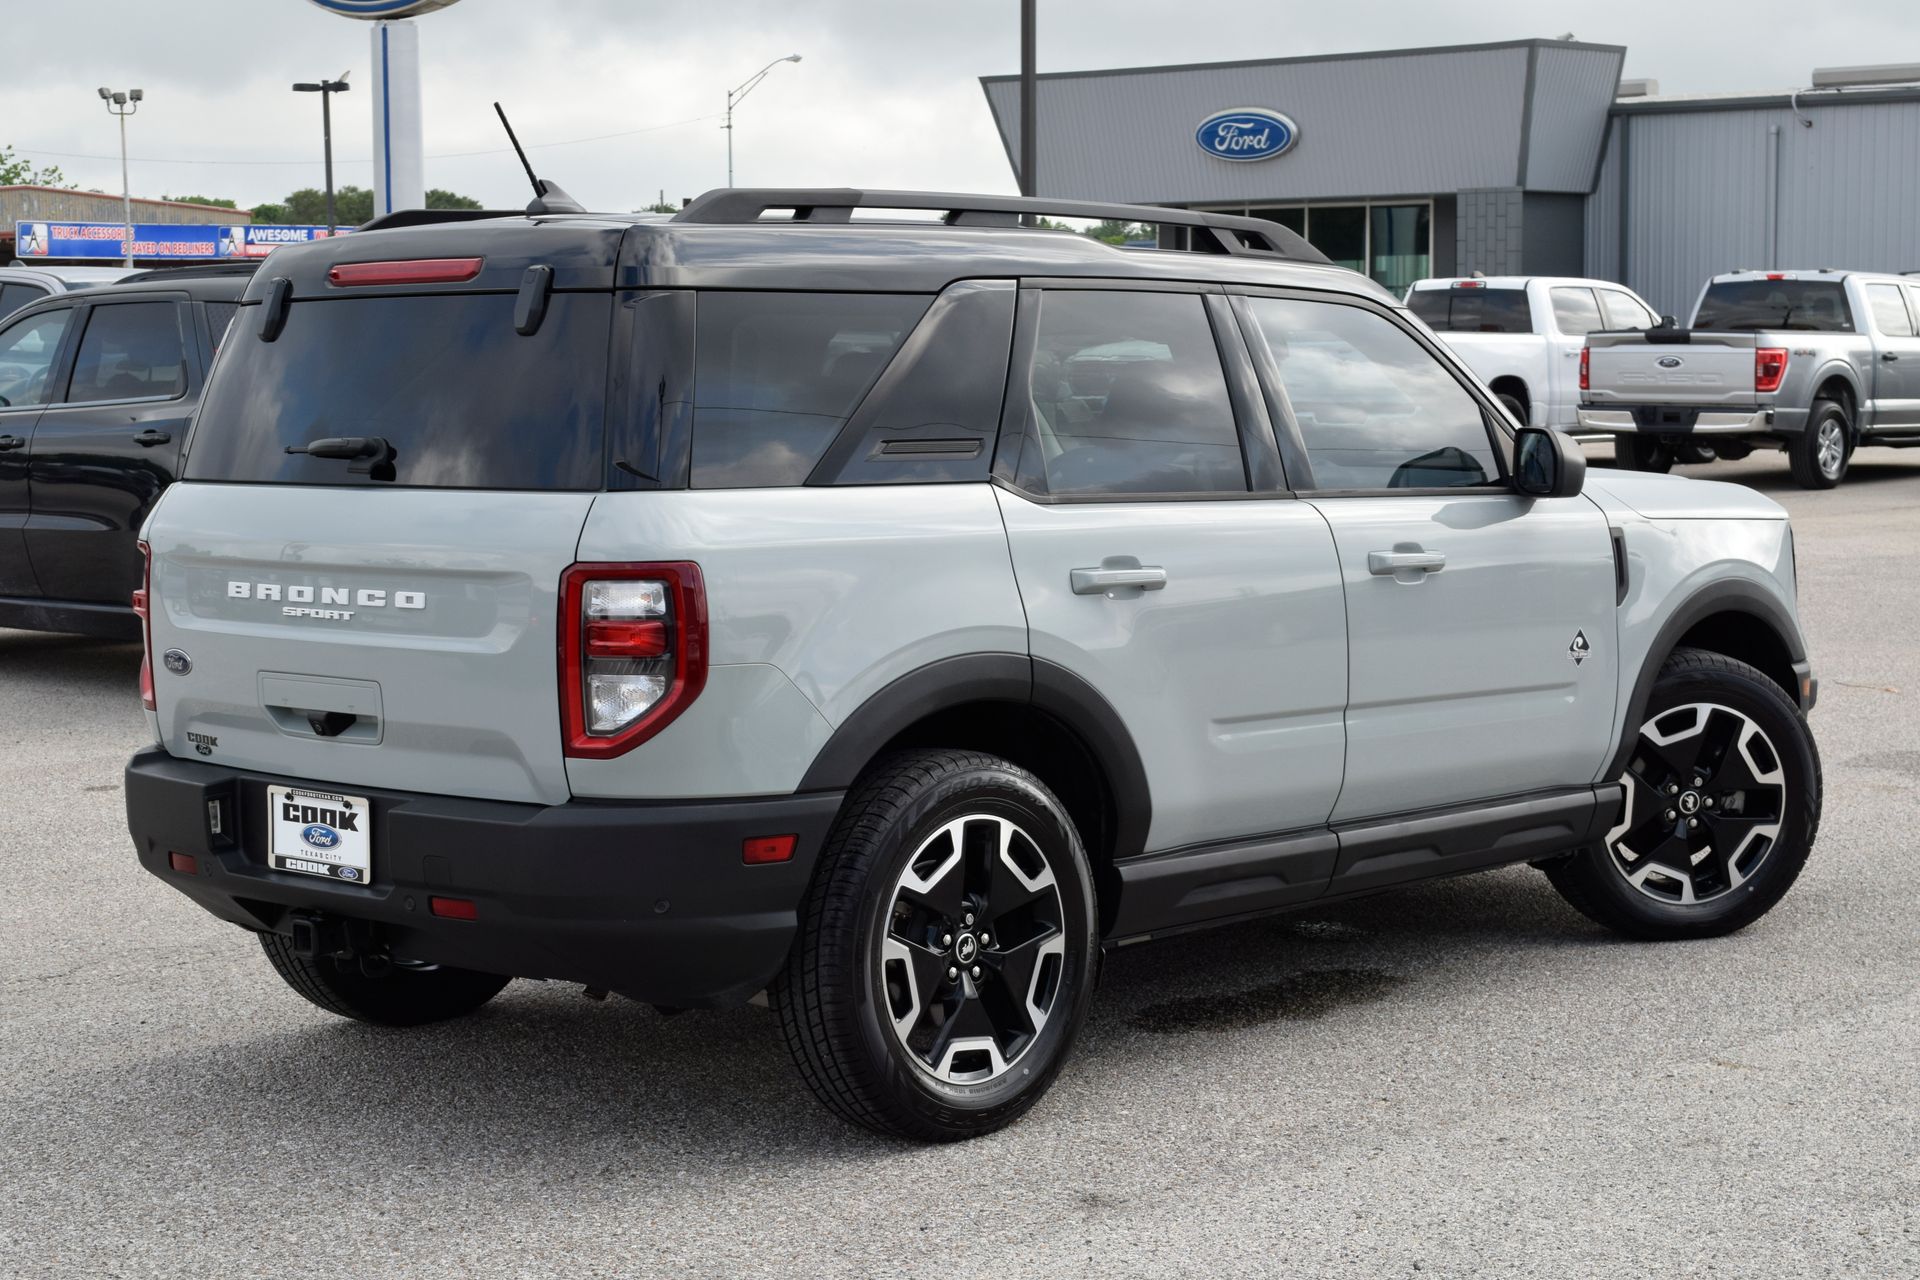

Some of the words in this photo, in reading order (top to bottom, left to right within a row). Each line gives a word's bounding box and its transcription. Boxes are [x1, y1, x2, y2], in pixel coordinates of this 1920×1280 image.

[1215, 122, 1270, 151] Ford
[51, 226, 80, 240] TRUCK
[80, 226, 135, 241] ACCESSORIS
[247, 227, 309, 242] AWESOME
[121, 240, 158, 255] SRAYED
[159, 241, 172, 255] ON
[172, 242, 214, 256] BEDLINERS
[1617, 371, 1724, 385] F-150
[227, 581, 426, 609] BRONCO
[282, 606, 355, 620] SPORT
[187, 731, 218, 747] COOK
[282, 802, 359, 832] COOK
[309, 827, 332, 846] Ford
[285, 858, 331, 875] COOK
